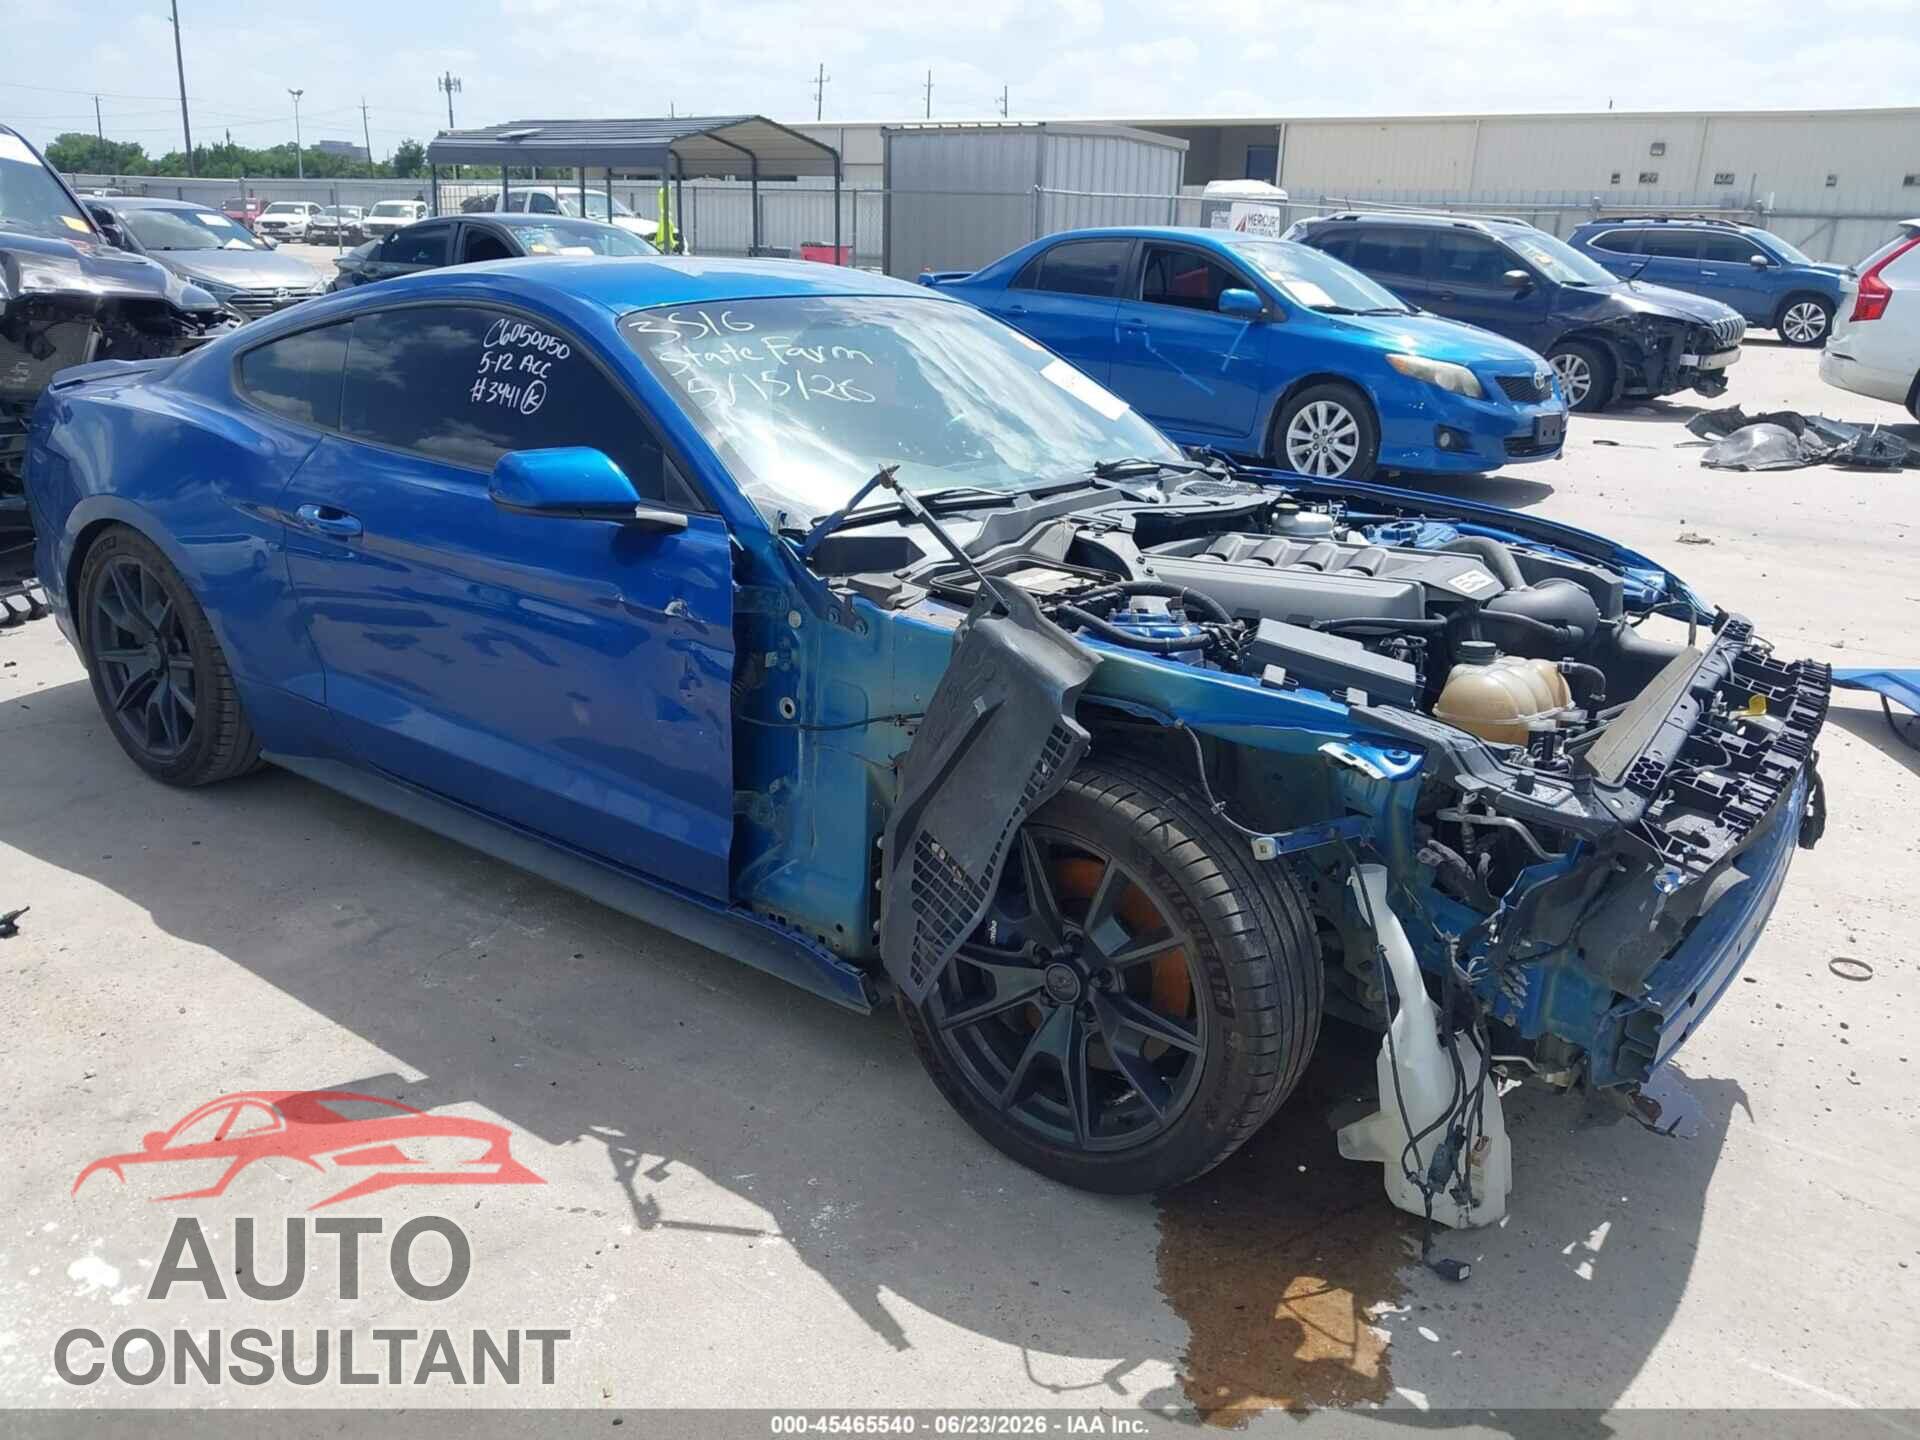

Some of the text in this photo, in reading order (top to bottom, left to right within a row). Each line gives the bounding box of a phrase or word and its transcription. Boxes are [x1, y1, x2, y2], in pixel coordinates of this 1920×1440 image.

[483, 318, 570, 360] C6050050
[659, 336, 874, 376] State Farm
[477, 351, 552, 379] 5-12 ACC
[687, 369, 876, 409] 5/15/26
